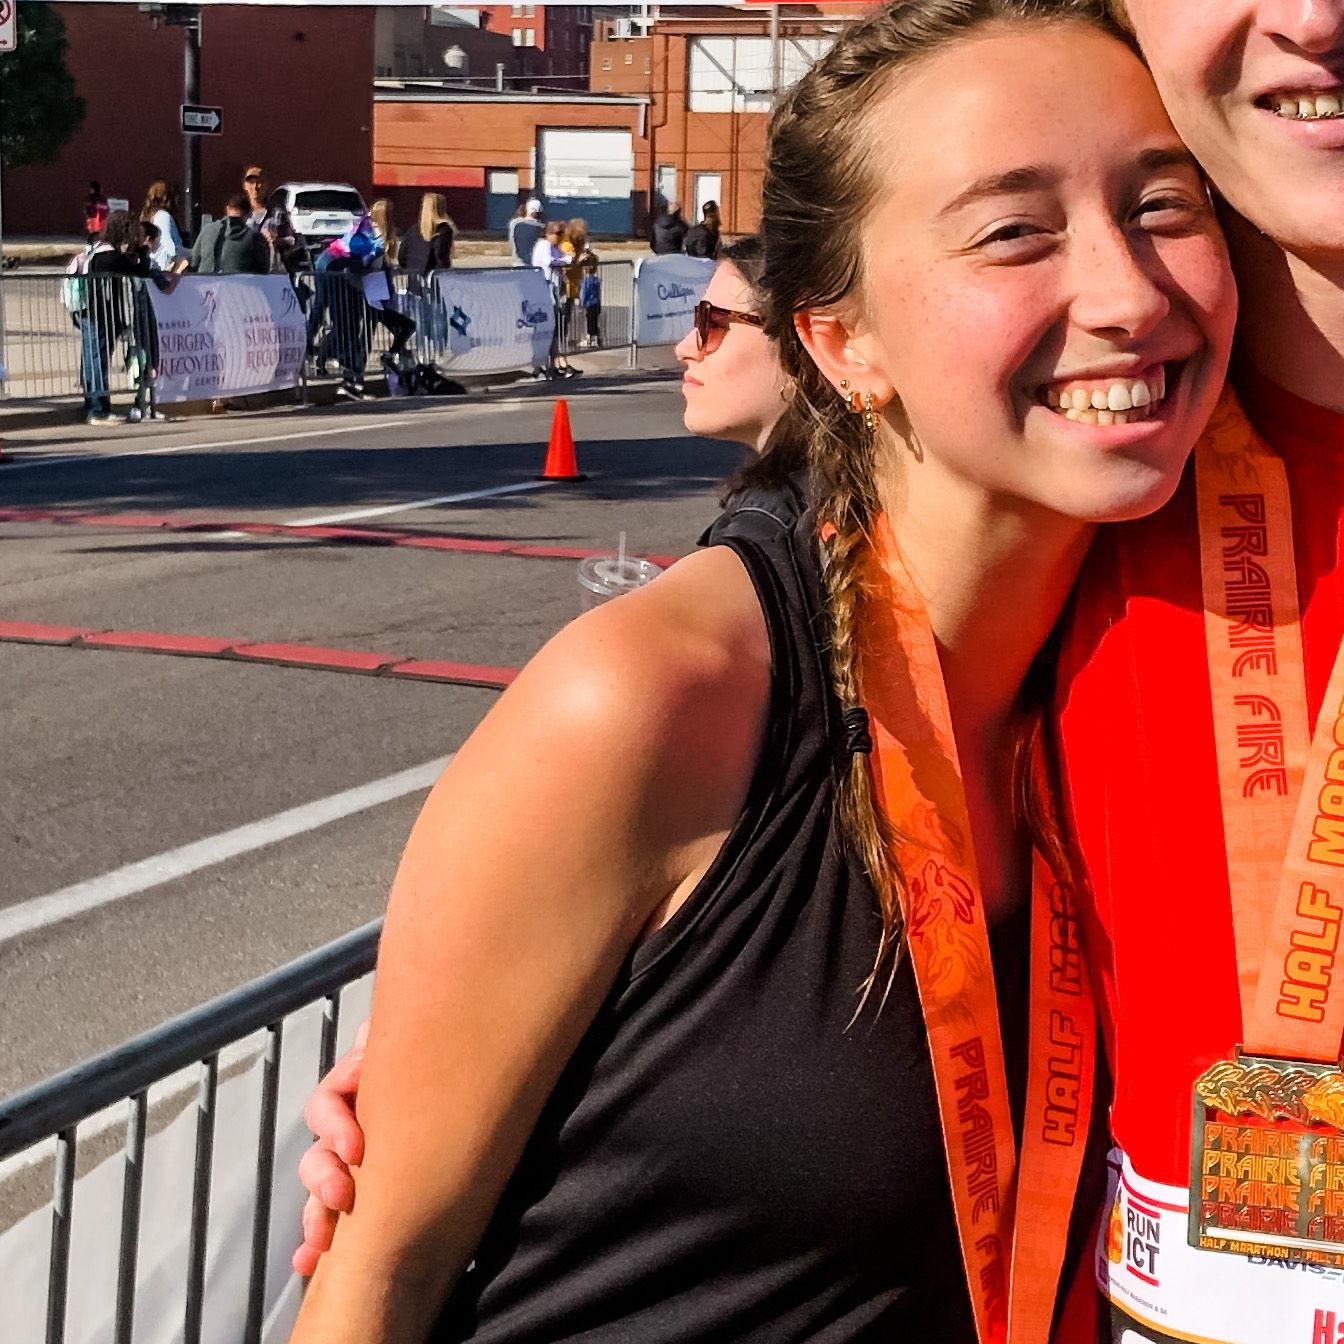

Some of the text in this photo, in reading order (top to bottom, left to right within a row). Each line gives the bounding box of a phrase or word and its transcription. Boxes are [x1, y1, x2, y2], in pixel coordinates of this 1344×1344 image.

[1217, 493, 1288, 798] PRAIRIE FIRE
[1277, 881, 1344, 1023] HALF
[1042, 1009, 1083, 1147] HALF
[949, 1036, 1001, 1225] PRAIRIE
[1204, 1123, 1302, 1156] PRAIRIE
[1203, 1150, 1301, 1185] PRAIRIE
[1202, 1176, 1300, 1210] PRAIRIE
[1127, 1207, 1160, 1244] RUN
[1200, 1201, 1299, 1235] PRAIRIE
[1127, 1232, 1160, 1275] ICT
[1199, 1237, 1226, 1249] HALF
